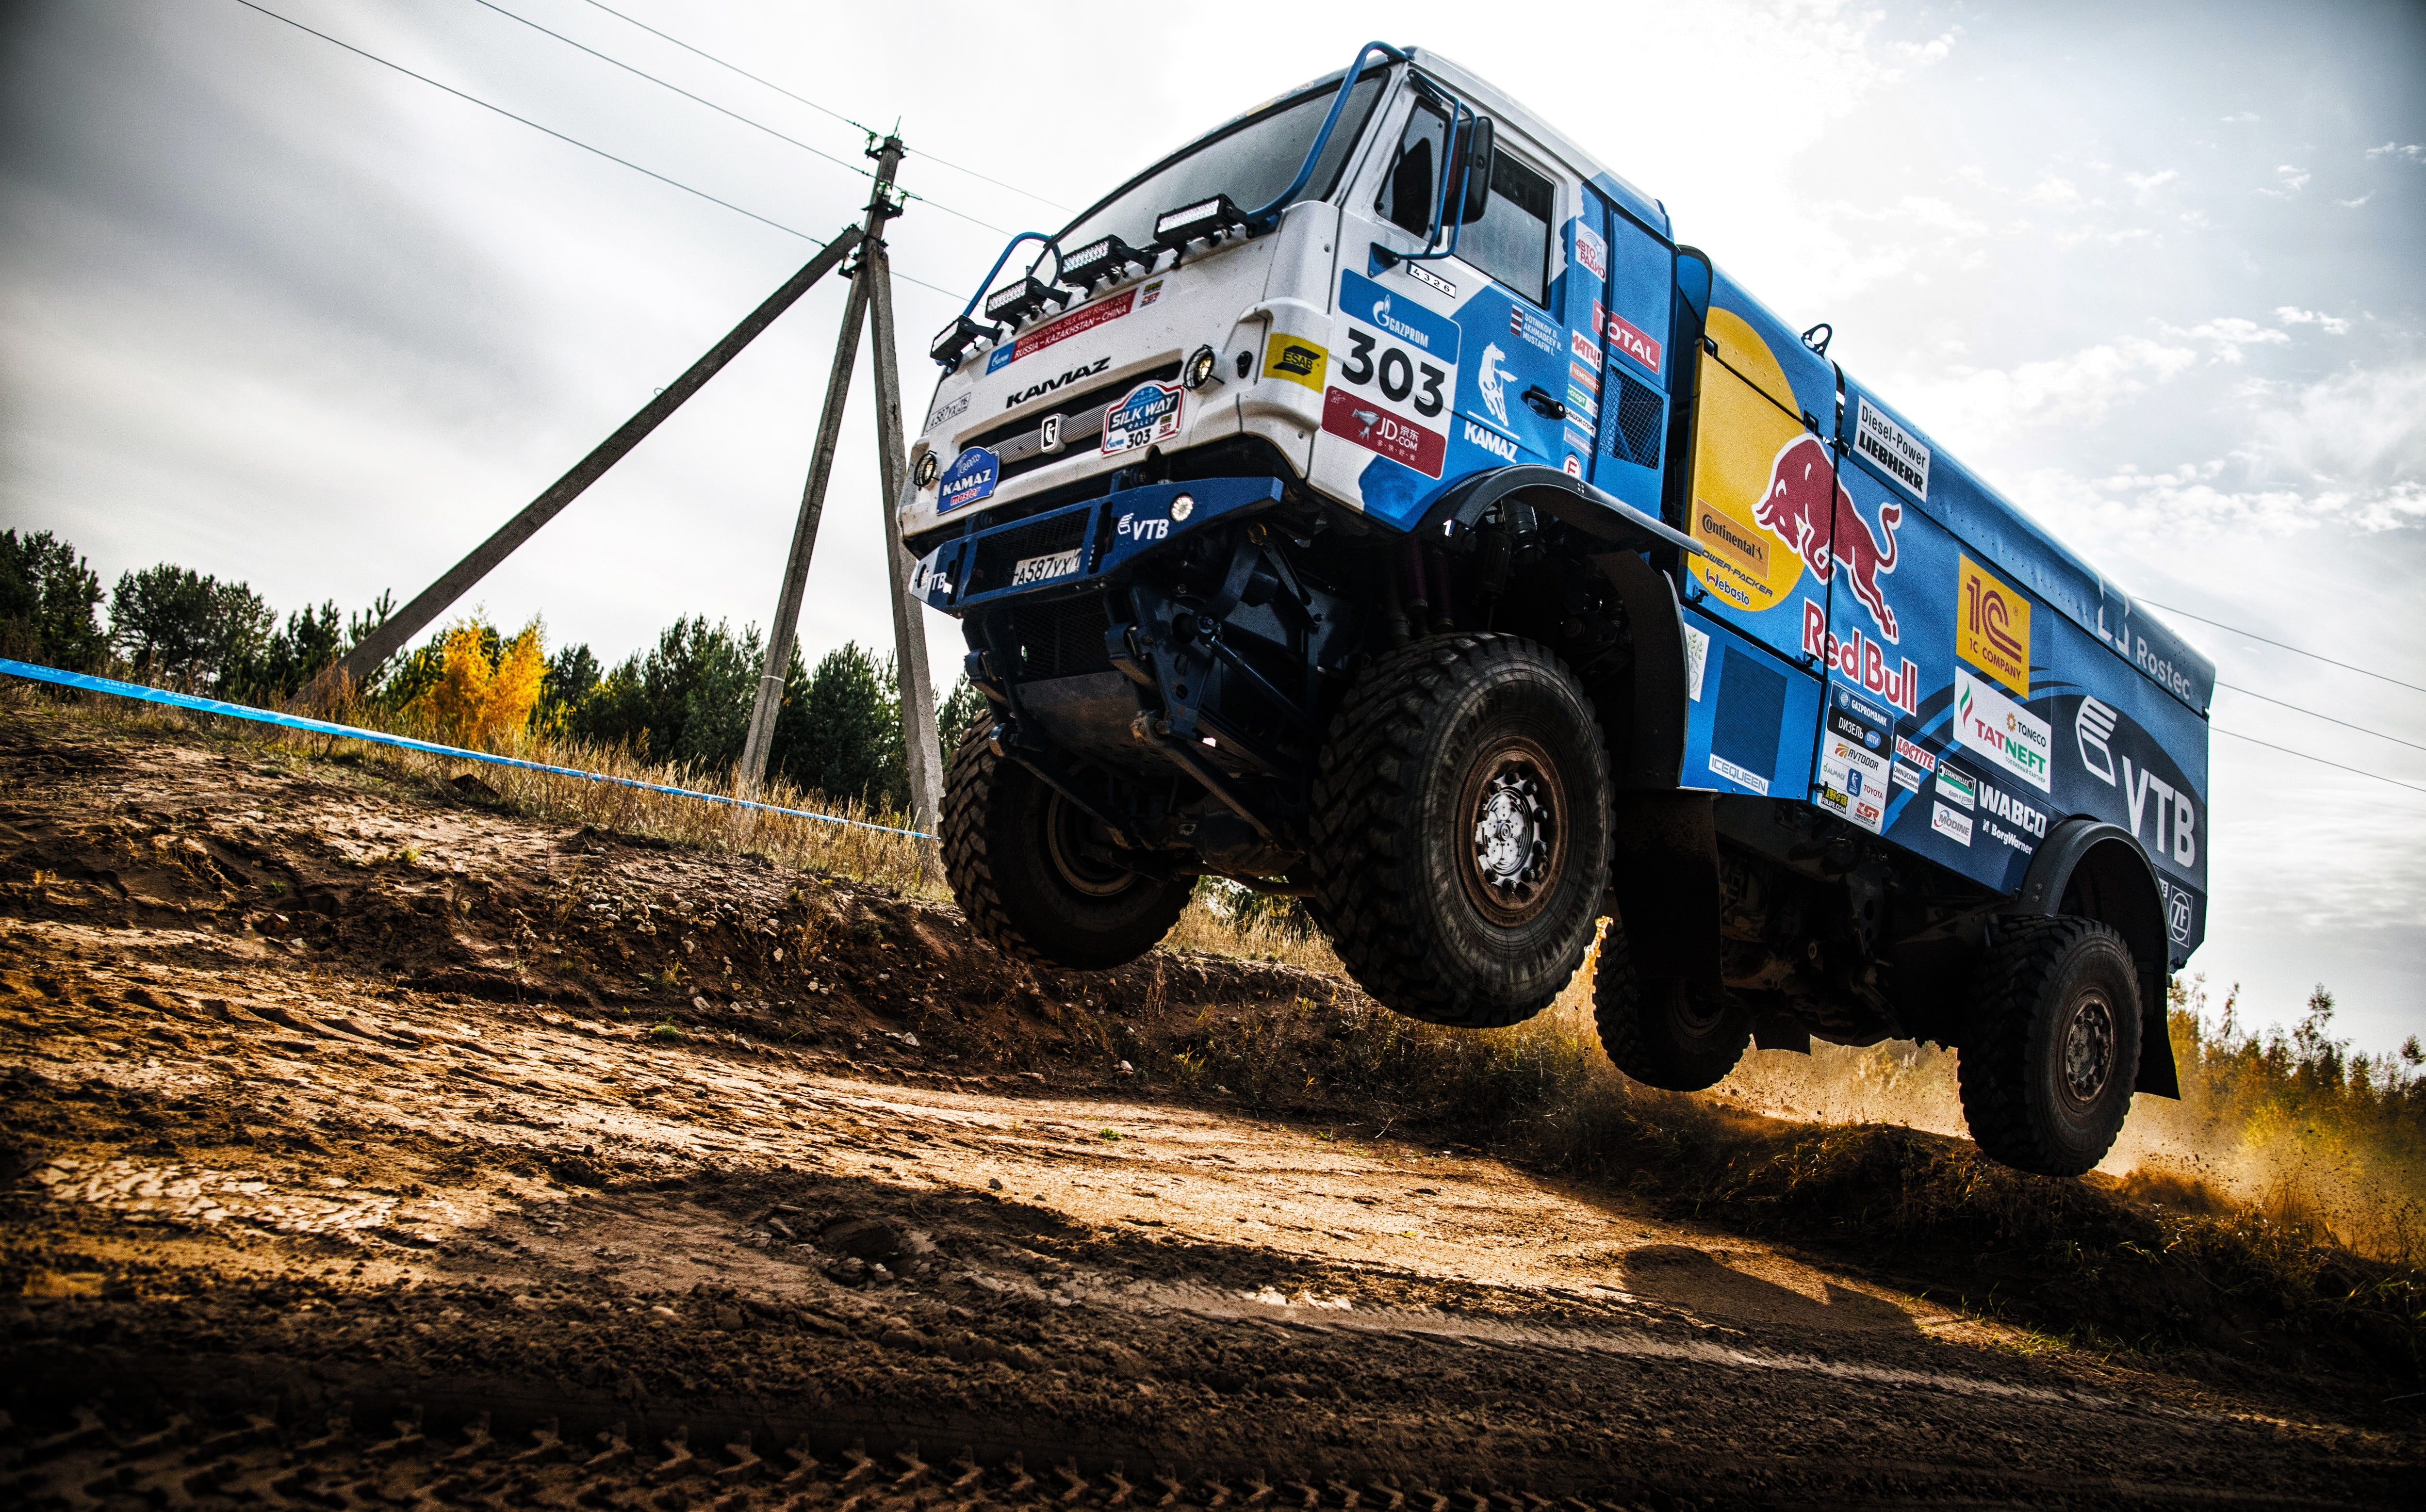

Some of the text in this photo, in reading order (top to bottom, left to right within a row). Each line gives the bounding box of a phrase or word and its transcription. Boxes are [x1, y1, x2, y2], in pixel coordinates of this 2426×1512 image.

[1576, 239, 1595, 259] АВТО
[1413, 268, 1450, 292] 4326
[1580, 252, 1605, 279] РАДИО
[1094, 301, 1114, 314] RALLY
[1014, 305, 1127, 359] RUSSIA KAZAKHSTAN CHINA
[1389, 317, 1429, 348] GAZPROM
[1524, 313, 1552, 335] SOTNIKOV
[1524, 323, 1556, 347] AKHMADEEV
[1596, 306, 1656, 367] TOTAL
[1523, 331, 1551, 353] MUSTAFIN
[1282, 352, 1312, 370] ESAB
[1342, 327, 1445, 417] 303
[1006, 357, 1112, 408] KAMAZ
[1573, 367, 1599, 391] ЧЕМПИОНАТ
[1111, 406, 1144, 429] SILK
[1145, 395, 1176, 417] WAY
[1128, 417, 1154, 430] RALLY
[1127, 428, 1151, 449] 303
[1399, 424, 1419, 442] 京东
[1464, 420, 1518, 464] KAMAZ
[1862, 405, 1926, 469] Diesel-Power
[1859, 430, 1923, 492] LIEBHERR
[942, 468, 992, 497] KAMAZ
[950, 487, 981, 505] master
[1133, 519, 1169, 540] VTB
[1703, 514, 1755, 558] Continental
[1701, 549, 1773, 598] OWER-PACKER
[1706, 568, 1749, 606] Webasto
[1803, 598, 1917, 715] Red Bull
[1982, 647, 2021, 681] COMPANY
[2137, 635, 2190, 700] Rostec
[1852, 699, 1887, 727] GAZPROMBANK
[1848, 748, 1879, 771] AVTODOR
[1896, 738, 1934, 769] LOCTITE
[1975, 718, 2046, 774] TATNEFT
[1712, 757, 1766, 792] ICEQUEEN
[2005, 757, 2046, 783] ТОПЛИВНЫЙ ПАРТНЕР
[1821, 797, 1846, 814] FBLIFE.COM
[1864, 784, 1883, 800] TOYOTA
[1949, 790, 1958, 798] Ключ
[1939, 814, 1969, 836] MODINE
[1979, 781, 2047, 839] WABCO
[2122, 755, 2195, 868] VTB
[1991, 823, 2033, 855] BorgWarner
[2173, 900, 2189, 934] ZF
